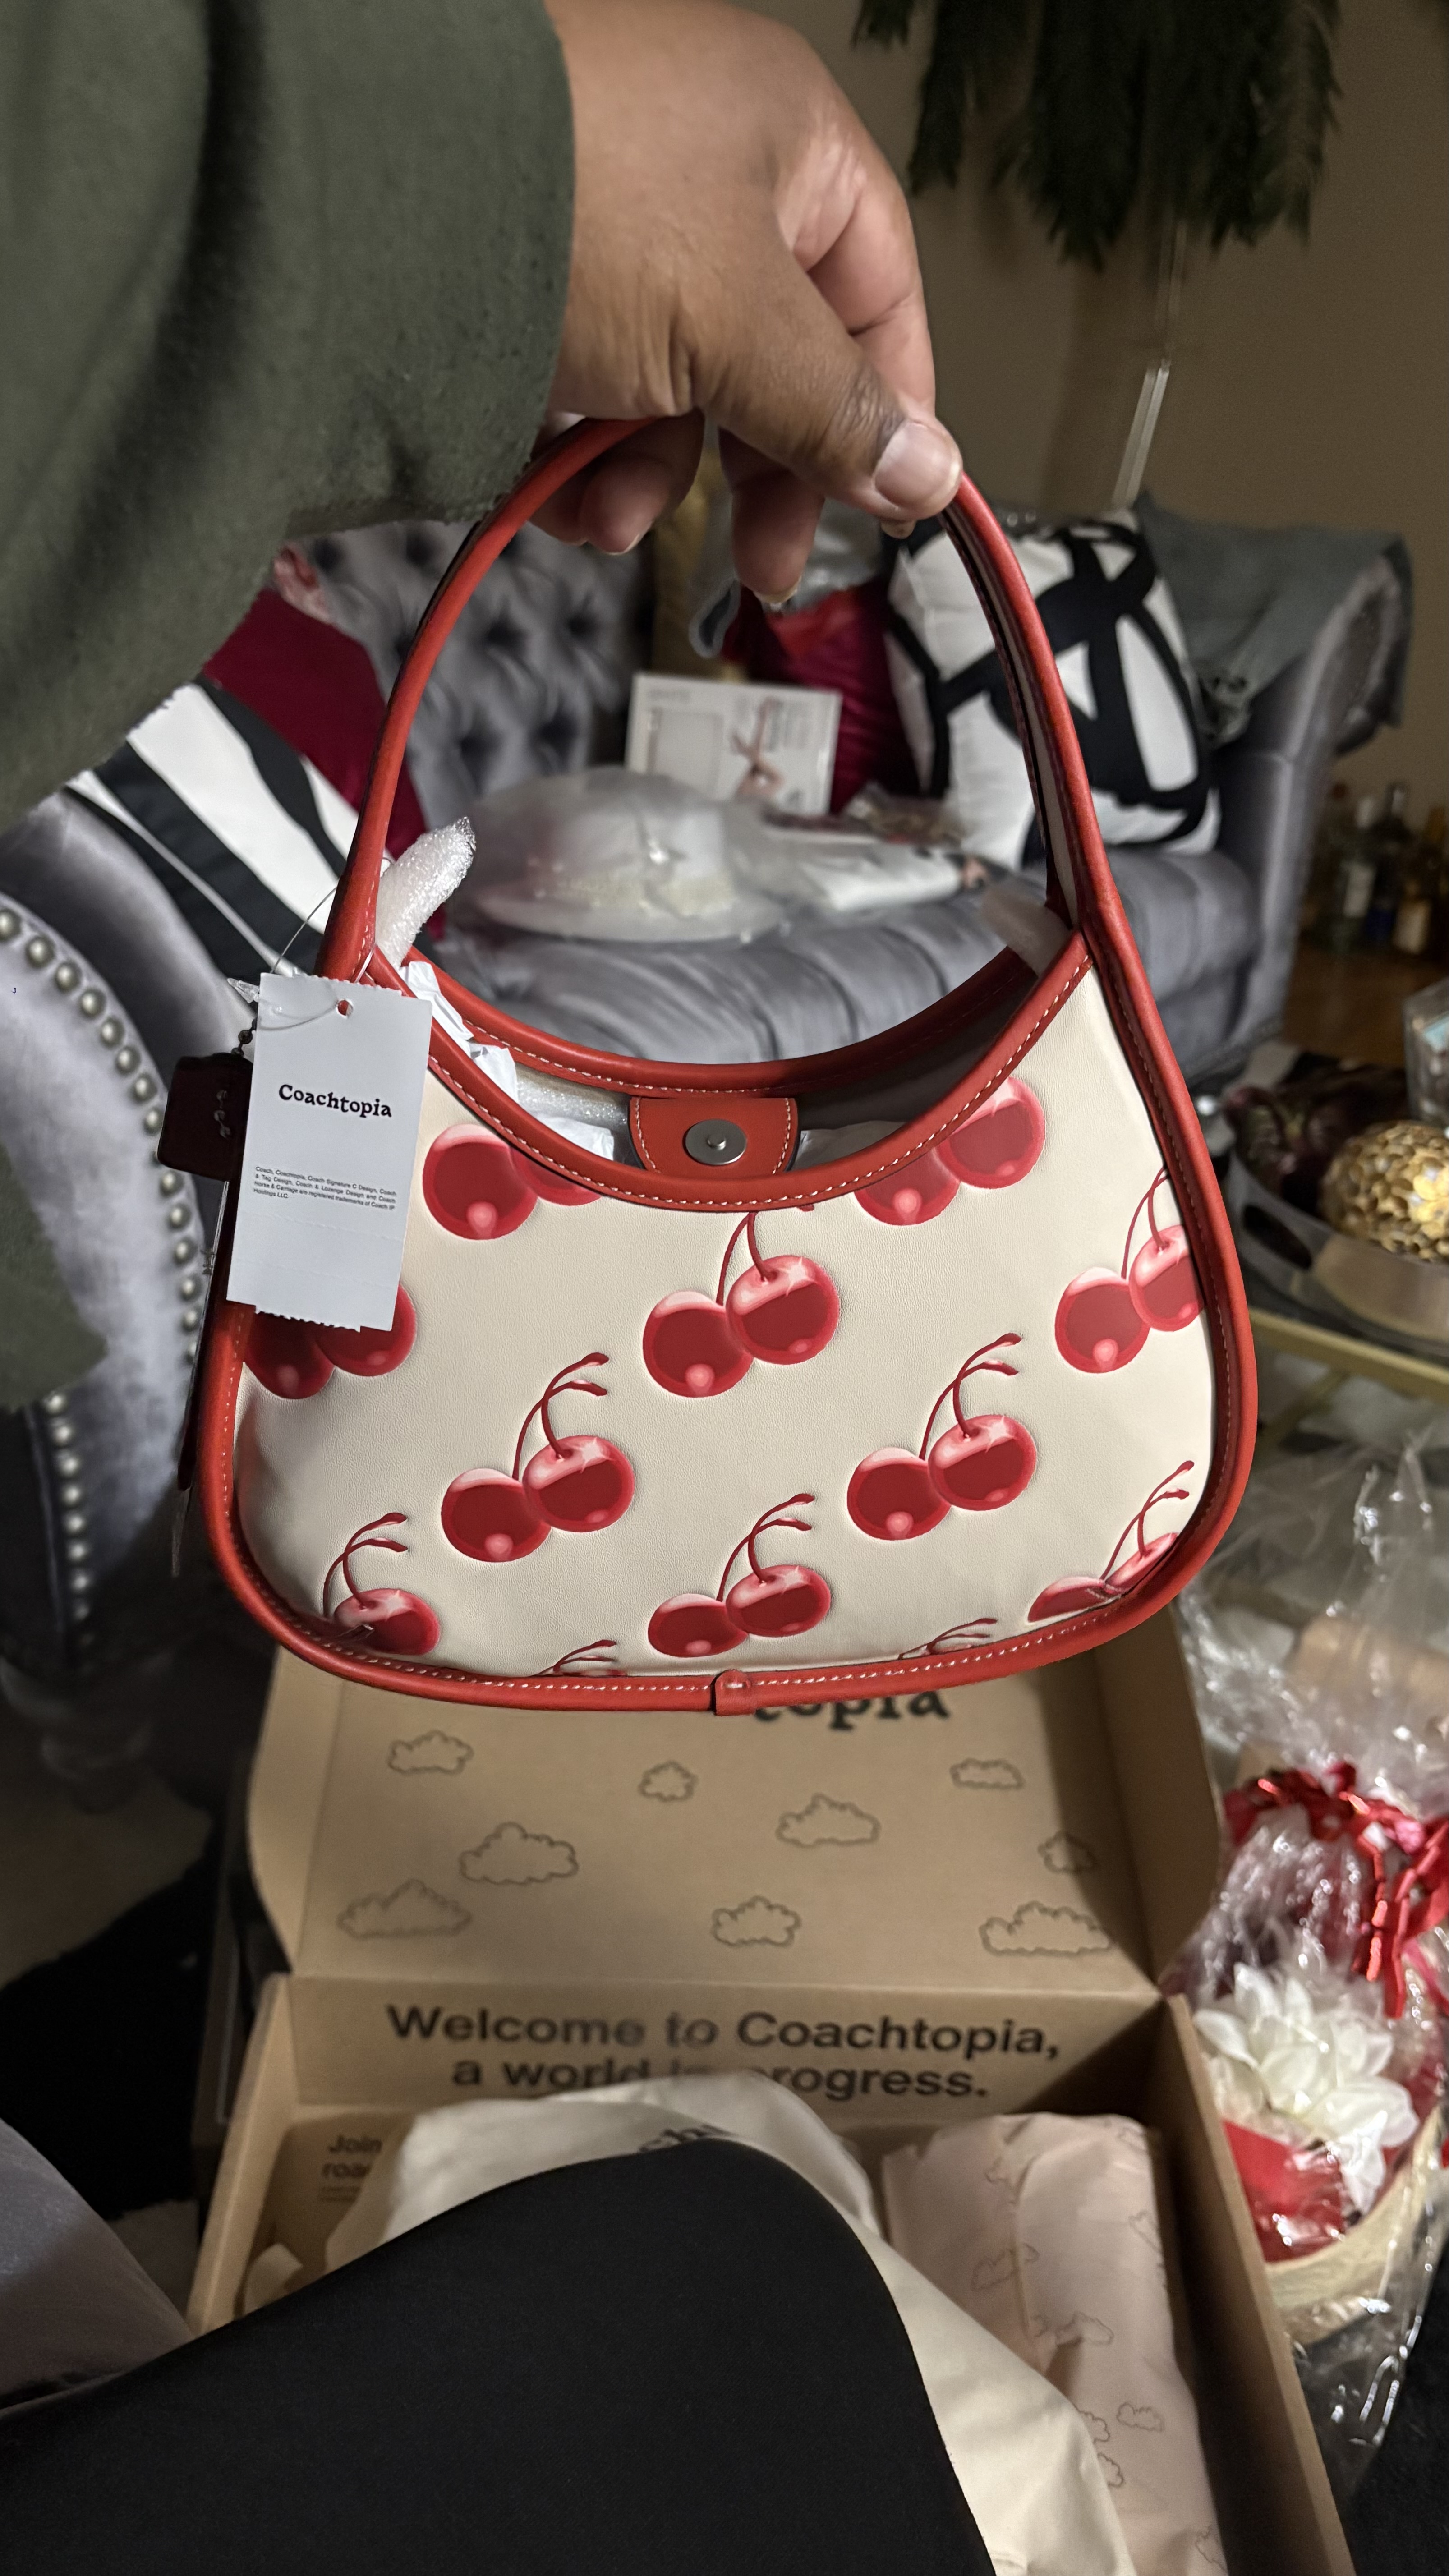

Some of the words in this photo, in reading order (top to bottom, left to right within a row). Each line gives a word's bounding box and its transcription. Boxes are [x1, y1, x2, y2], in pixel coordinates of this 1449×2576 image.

[279, 1084, 392, 1118] Coachtopia
[253, 1188, 276, 1196] Holdings
[321, 1185, 343, 1194] Lozenge
[346, 1190, 364, 1198] Design
[327, 1179, 350, 1187] Signature
[276, 1185, 298, 1193] Carriage
[308, 1191, 334, 1200] registered
[335, 1196, 363, 1205] trademarks
[386, 2004, 646, 2047] Welcome
[666, 2011, 719, 2048] to
[737, 2011, 1058, 2060] Coachtopia,
[454, 2060, 481, 2086] a
[503, 2057, 651, 2088] world
[750, 2066, 987, 2101] rogress.
